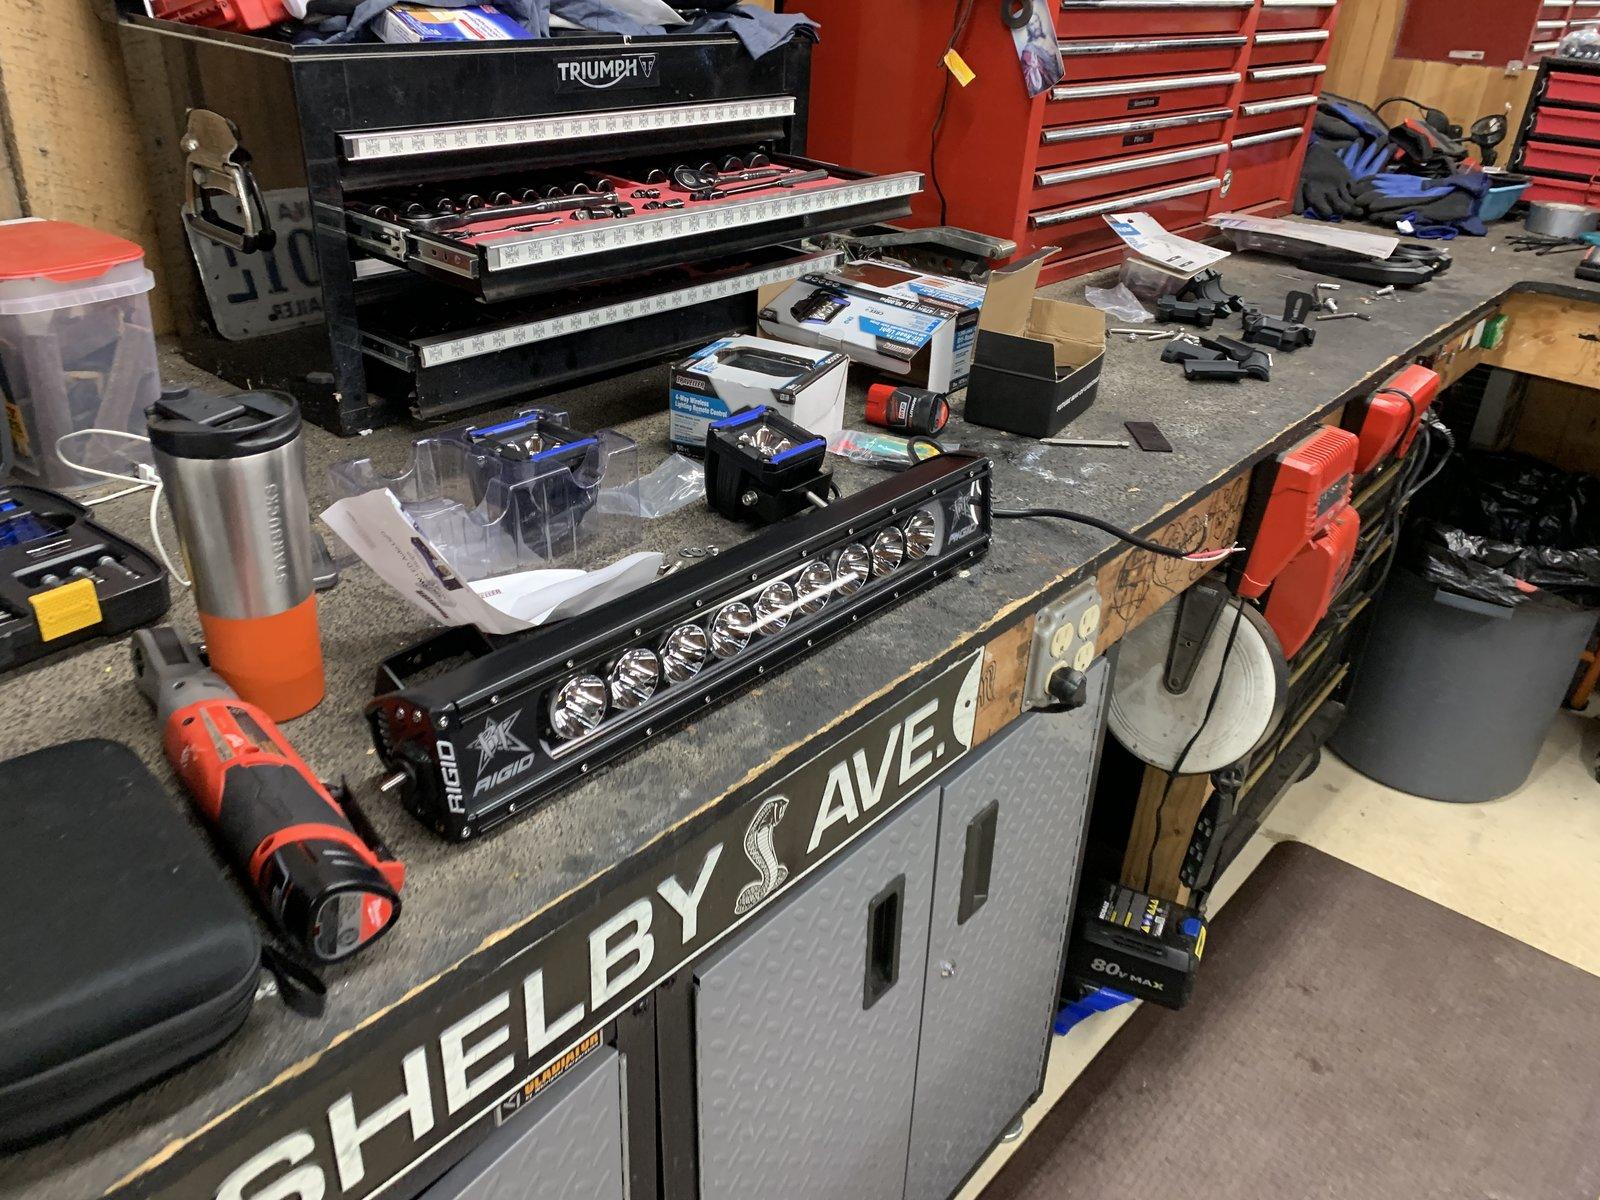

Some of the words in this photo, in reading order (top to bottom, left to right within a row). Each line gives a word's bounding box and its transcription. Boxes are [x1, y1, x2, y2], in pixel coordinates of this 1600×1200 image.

[557, 59, 638, 87] TRIUMPH
[674, 401, 692, 411] Lighting
[692, 404, 710, 415] Remote
[710, 409, 728, 418] Control
[690, 397, 710, 407] Wireless
[264, 483, 287, 585] STARBUCKS
[436, 740, 466, 814] RIGID
[472, 752, 536, 798] RIGID
[214, 842, 724, 1200] SHELBY
[806, 698, 945, 854] AVE.
[1130, 974, 1164, 991] MAX
